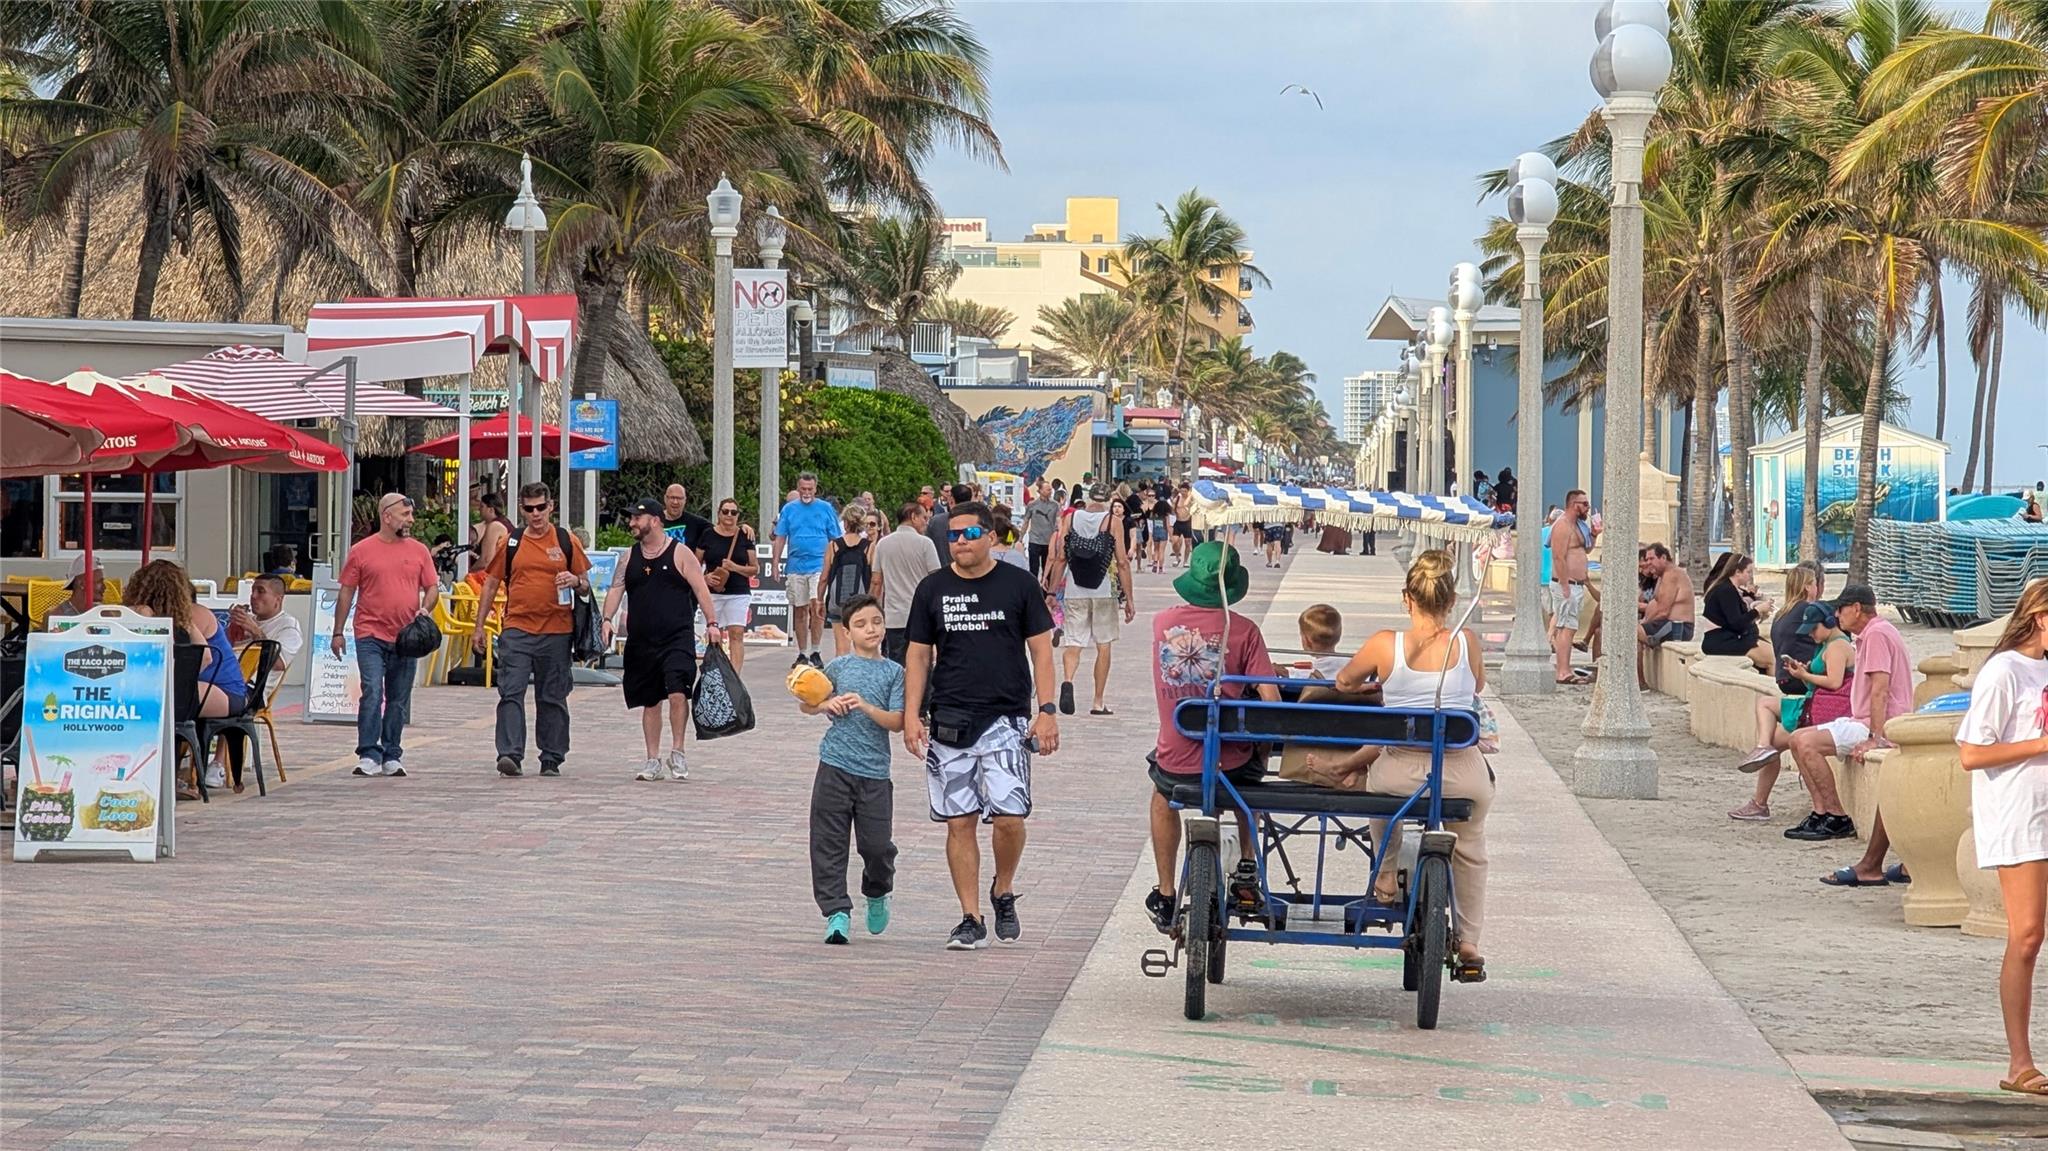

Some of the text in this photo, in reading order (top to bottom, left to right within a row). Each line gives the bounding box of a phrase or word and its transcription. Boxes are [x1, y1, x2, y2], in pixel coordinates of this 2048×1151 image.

[734, 310, 785, 326] PETS
[735, 327, 785, 337] ALLOWED
[306, 453, 326, 465] ARTOIS
[1834, 449, 1891, 461] BEH
[1832, 464, 1891, 477] SHK
[757, 606, 787, 616] ALL SHOTS
[942, 603, 968, 613] Sol&
[944, 621, 989, 632] Futebol.
[67, 658, 125, 666] THE TACO JOINT
[73, 686, 111, 701] THE
[63, 723, 124, 732] HOLLYWOOD
[100, 796, 138, 809] Coco
[22, 813, 71, 824] Colada
[98, 810, 138, 822] Loco
